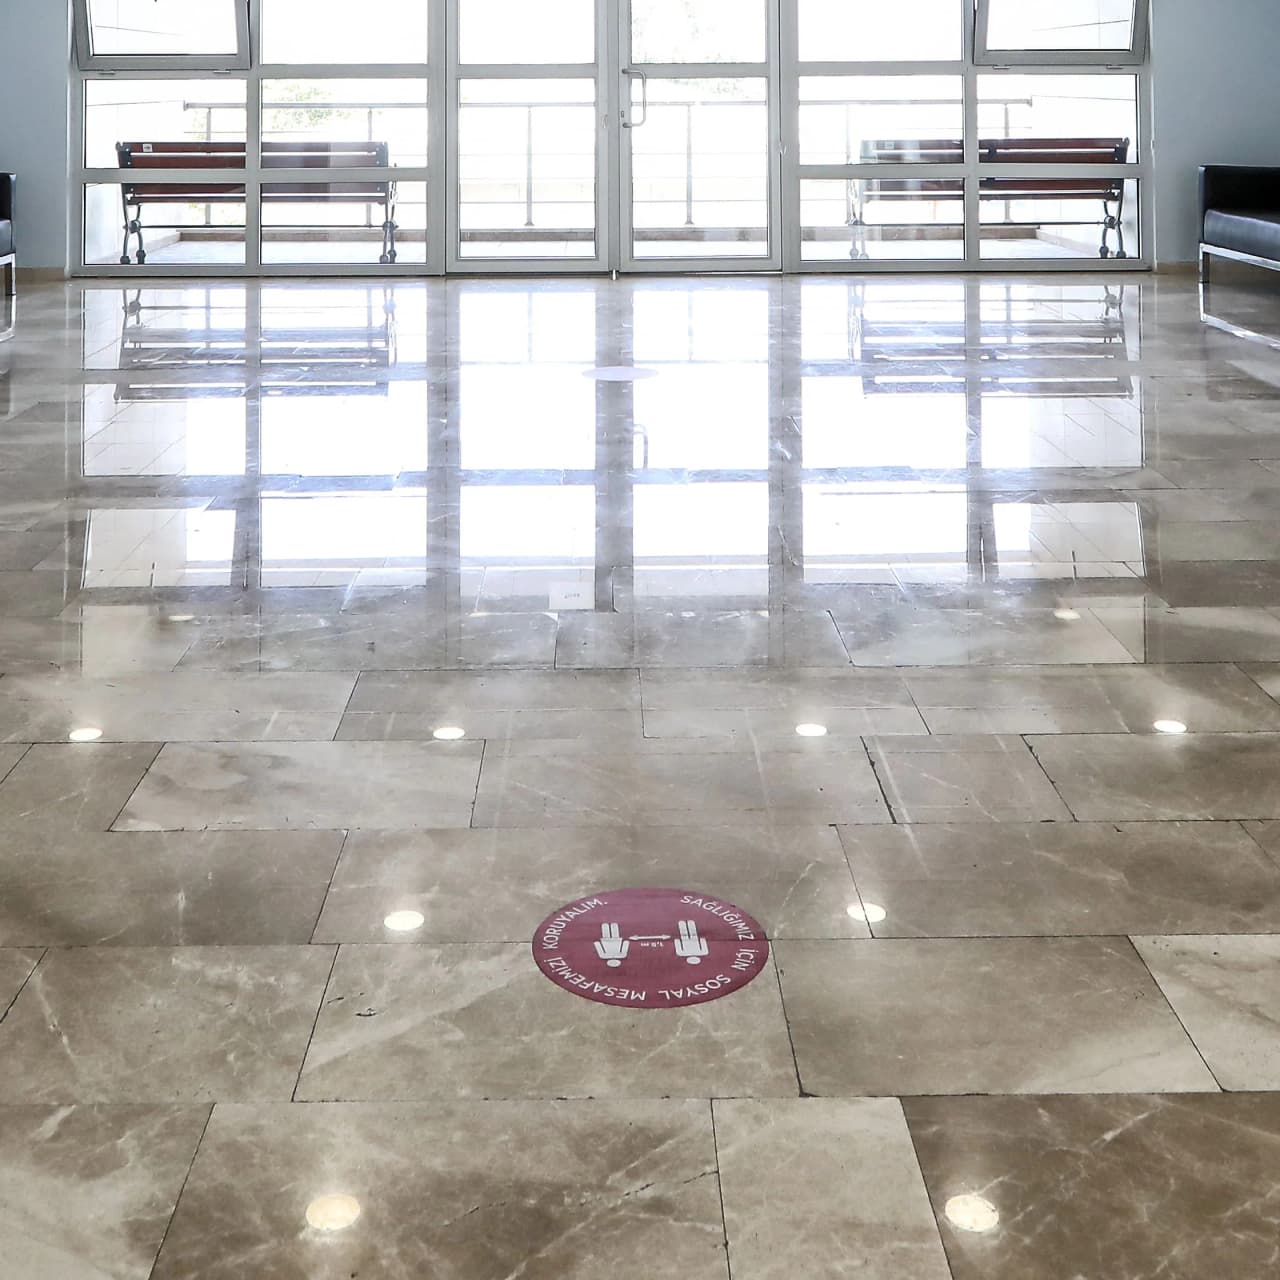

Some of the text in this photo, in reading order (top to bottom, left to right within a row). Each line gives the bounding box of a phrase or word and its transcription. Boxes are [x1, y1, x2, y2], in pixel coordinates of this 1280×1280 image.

[680, 895, 755, 941] SAĞLIĞIMIZ
[731, 948, 760, 972] İÇİN
[543, 957, 647, 1001] MESAFEMİZİ
[658, 974, 733, 1000] SOSYAL
